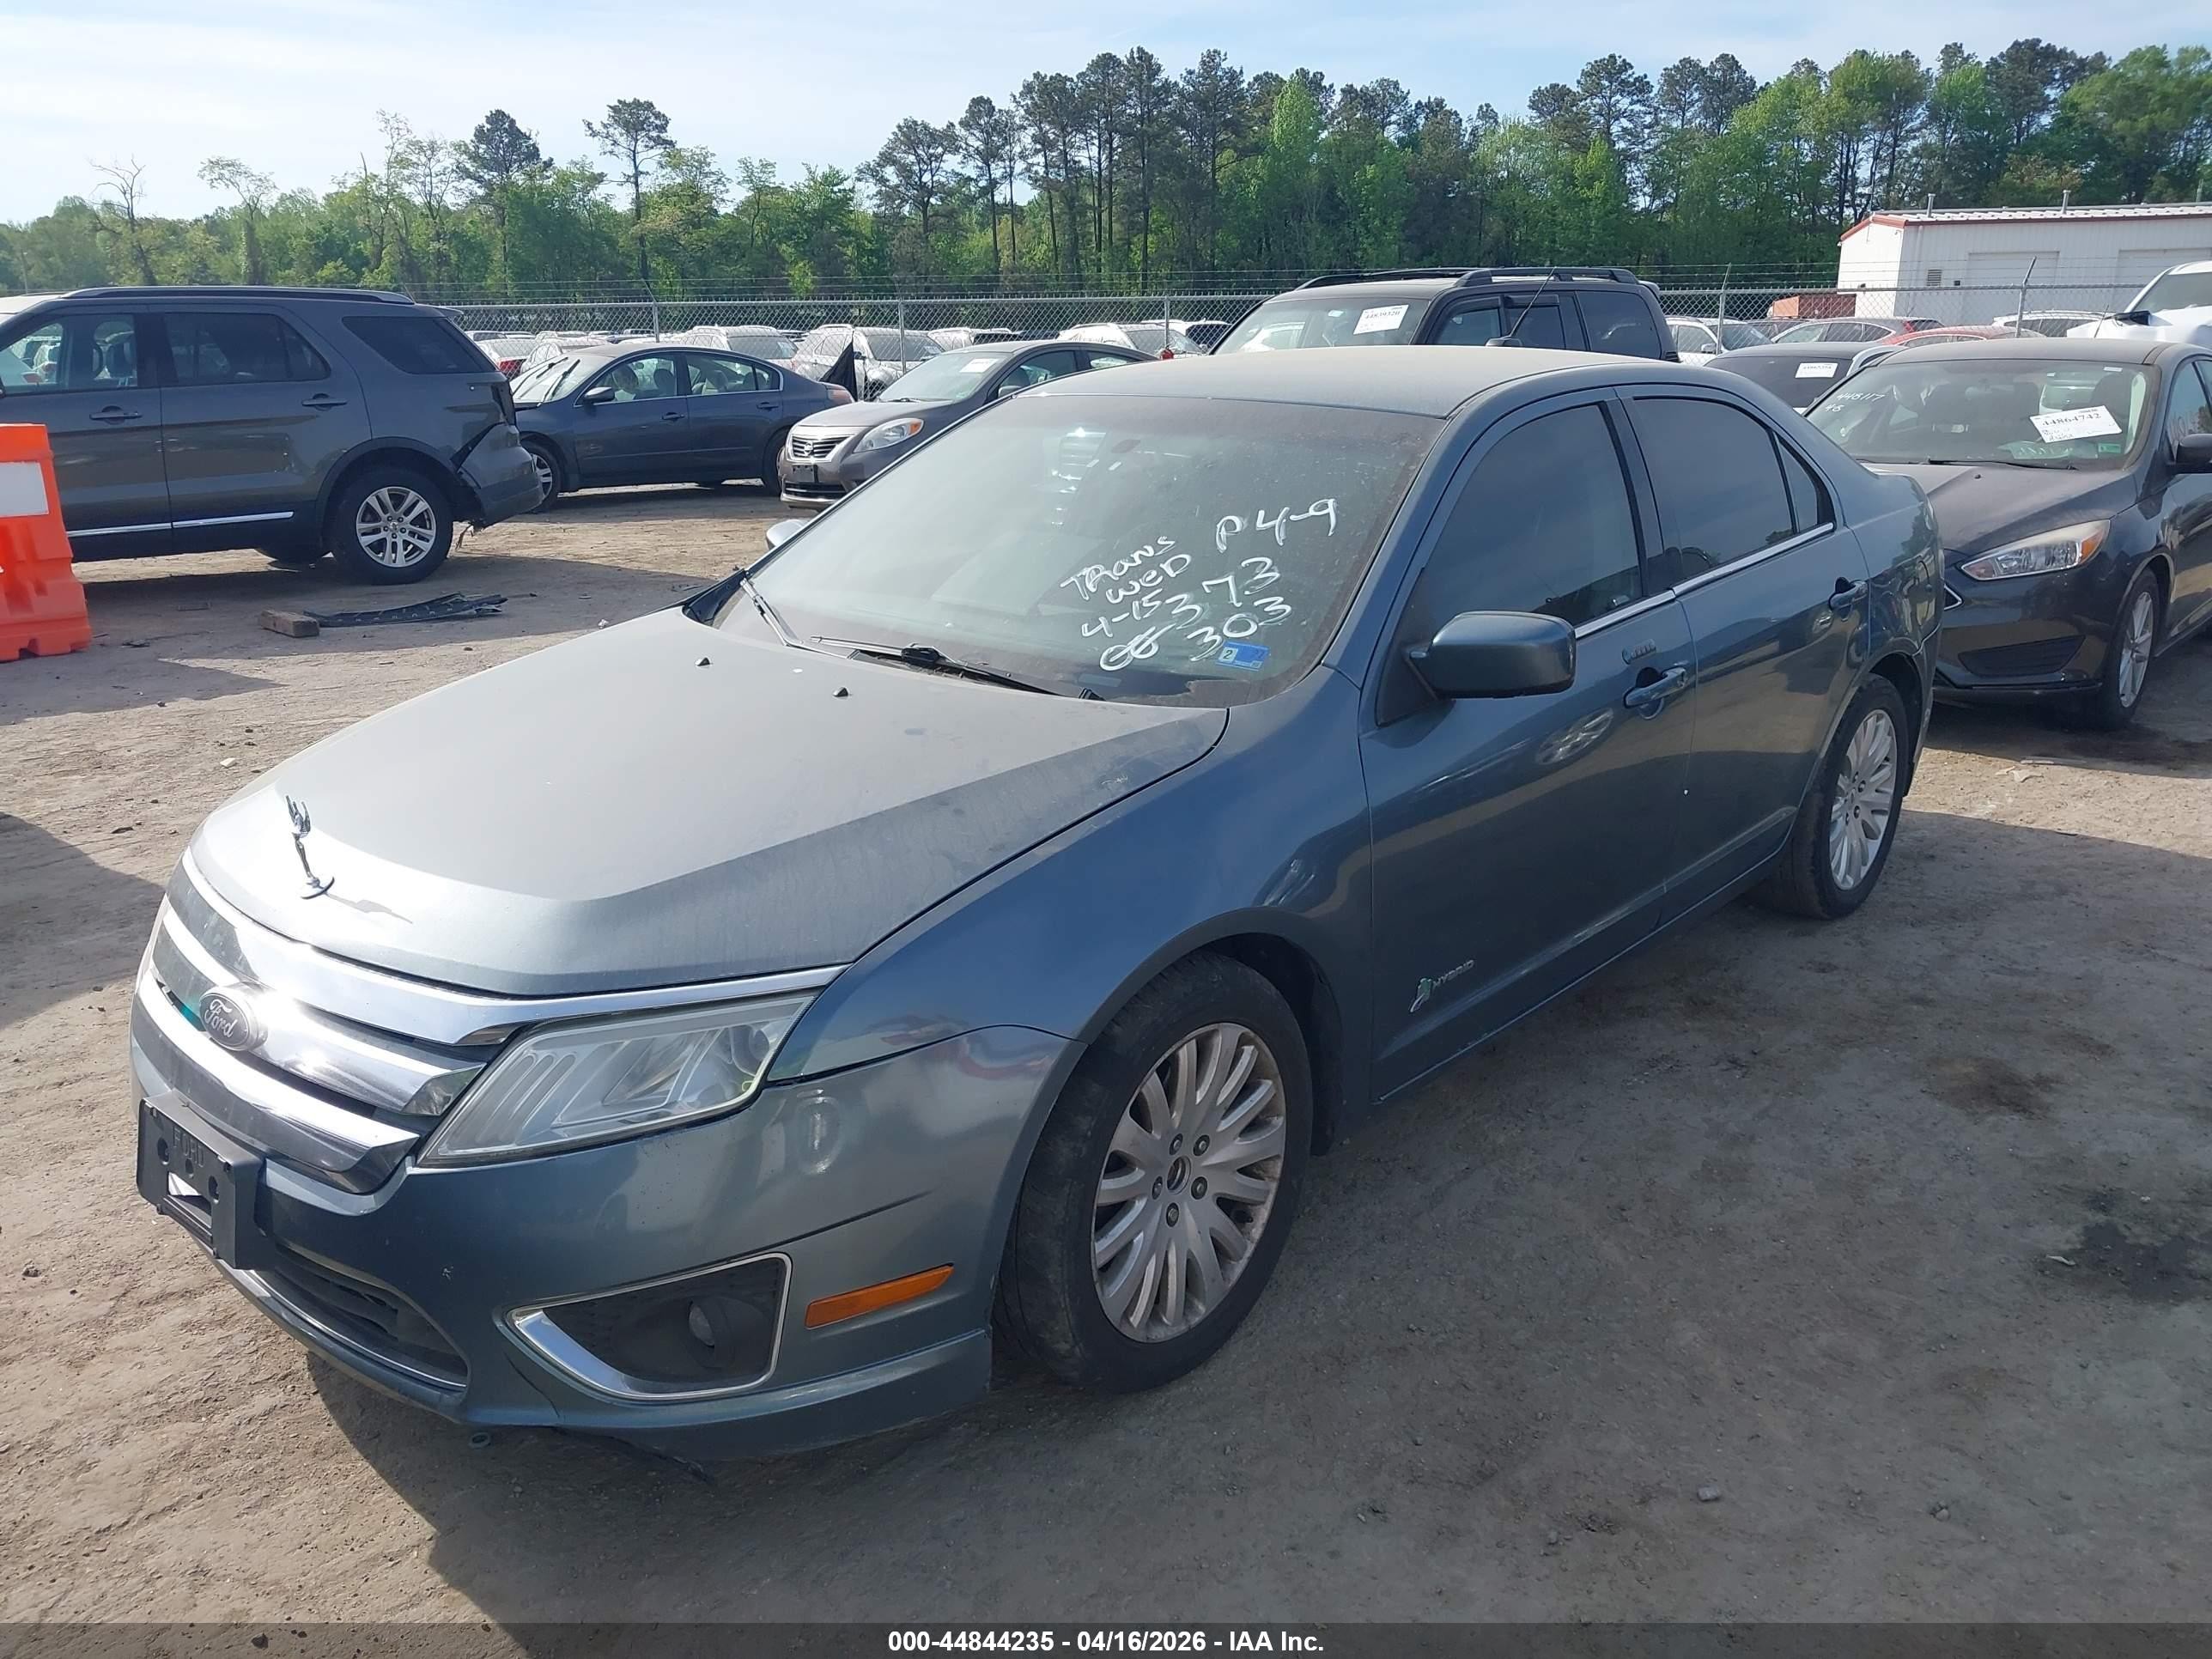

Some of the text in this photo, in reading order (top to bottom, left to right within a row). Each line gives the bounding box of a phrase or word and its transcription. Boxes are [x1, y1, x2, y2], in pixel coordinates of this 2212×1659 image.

[1223, 649, 1233, 659] 2
[204, 998, 238, 1038] Ford
[173, 1127, 205, 1168] FORD
